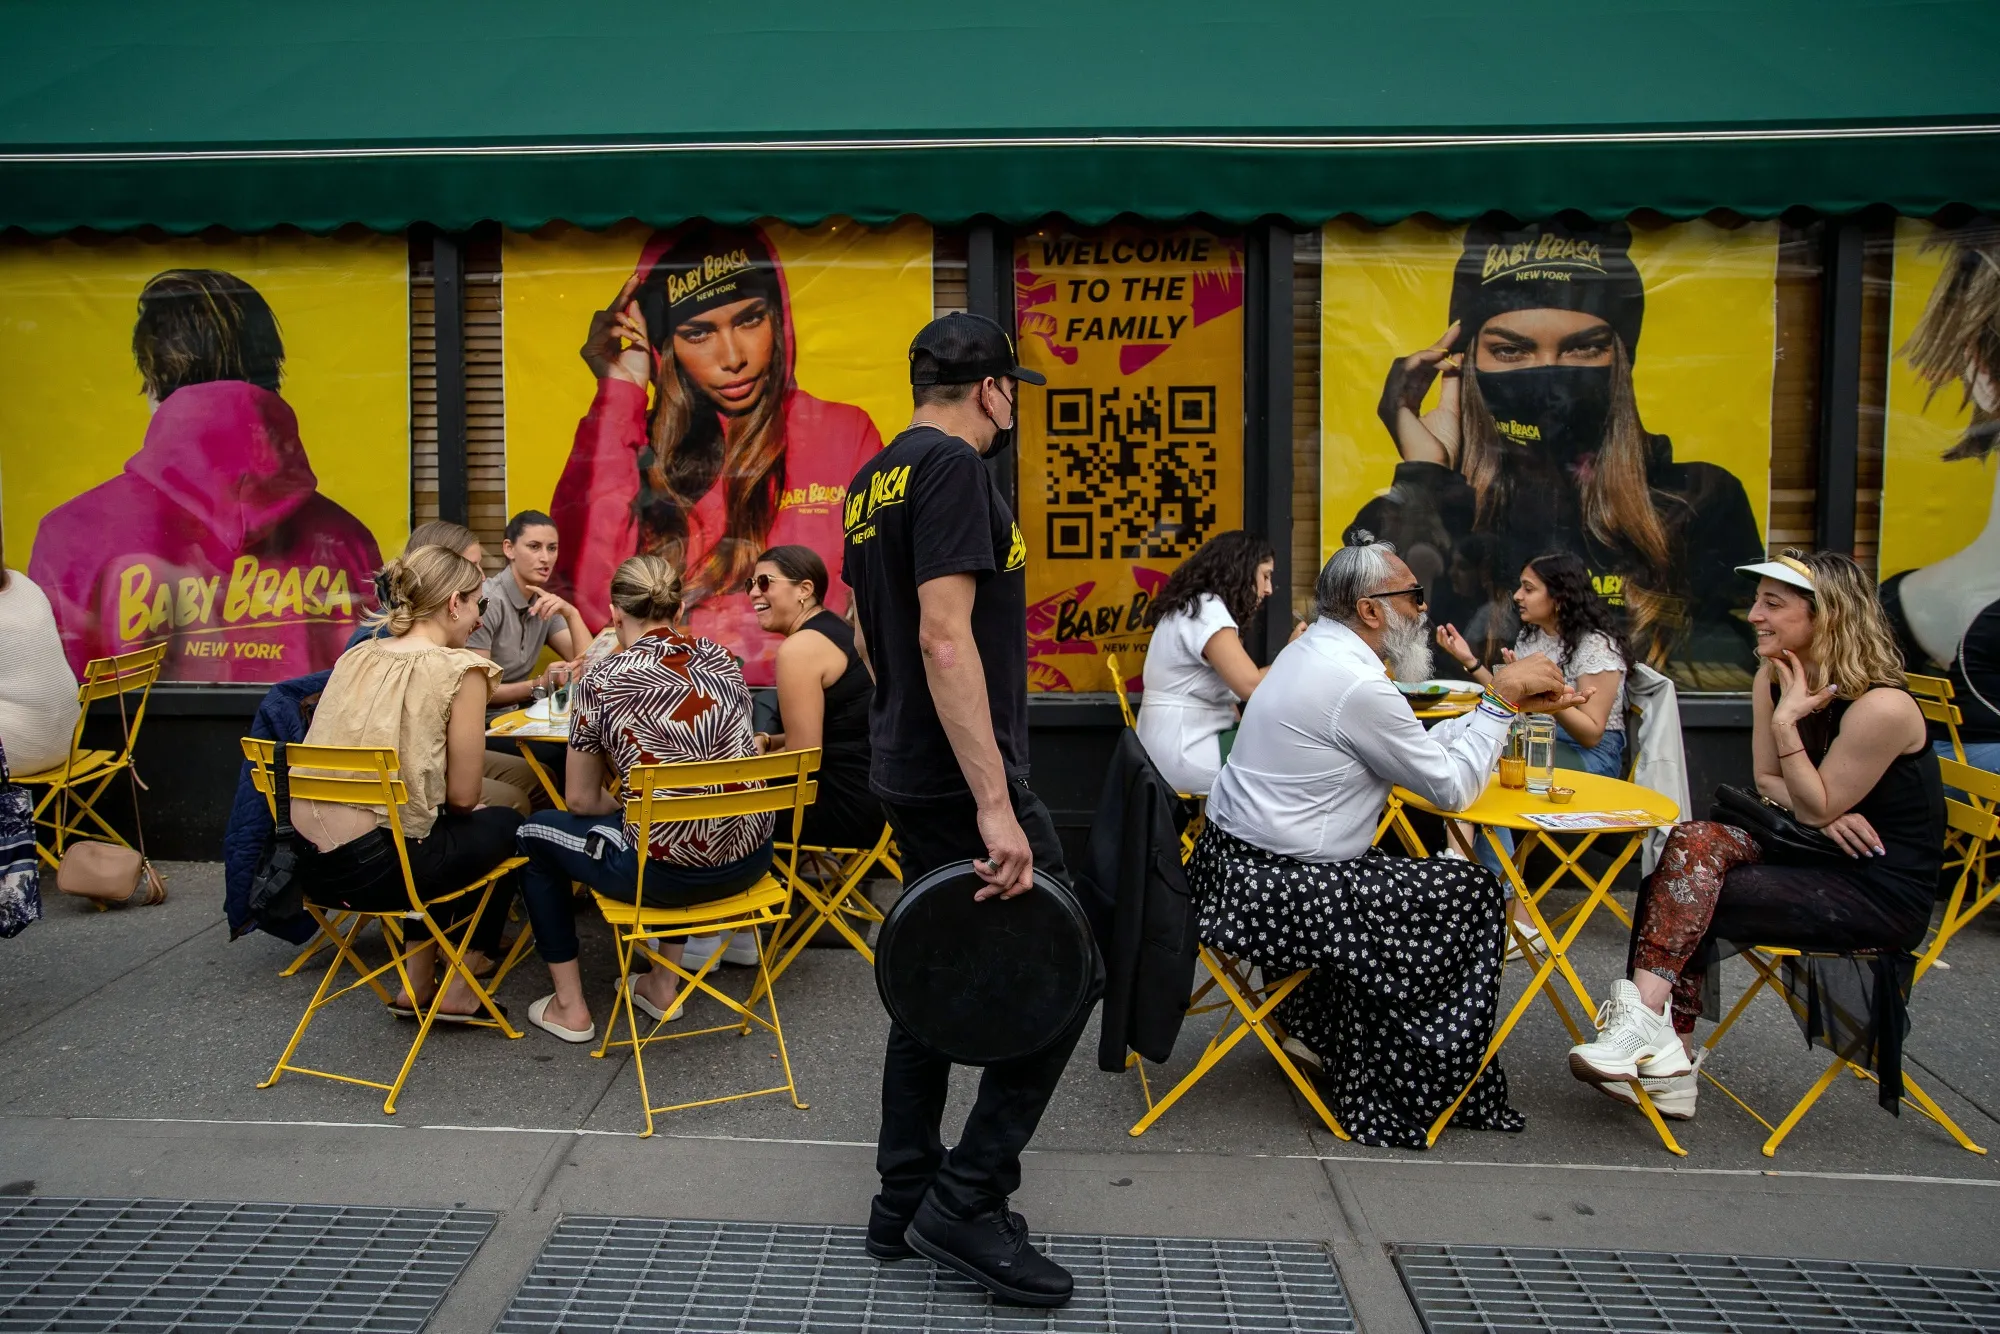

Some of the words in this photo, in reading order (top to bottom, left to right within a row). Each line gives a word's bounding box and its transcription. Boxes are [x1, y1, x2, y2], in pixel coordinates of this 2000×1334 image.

[1042, 238, 1211, 266] WELCOME
[1482, 240, 1535, 278] BABY
[1535, 233, 1602, 265] BRASA
[667, 266, 701, 303] BABY
[704, 248, 752, 281] BRASA
[1515, 271, 1541, 281] NEW
[1542, 270, 1572, 281] YORK
[696, 289, 715, 302] NEW
[715, 282, 737, 295] YORK
[1068, 279, 1110, 303] TO
[1122, 277, 1186, 302] THE
[1065, 315, 1188, 342] FAMILY
[1510, 420, 1540, 438] BRASA
[119, 563, 221, 641] BABY
[223, 555, 352, 623] BRASA
[1055, 598, 1124, 642] BABY
[184, 640, 229, 657] NEW
[233, 642, 286, 660] YORK
[1102, 643, 1130, 652] NEW
[1133, 643, 1148, 652] YO
